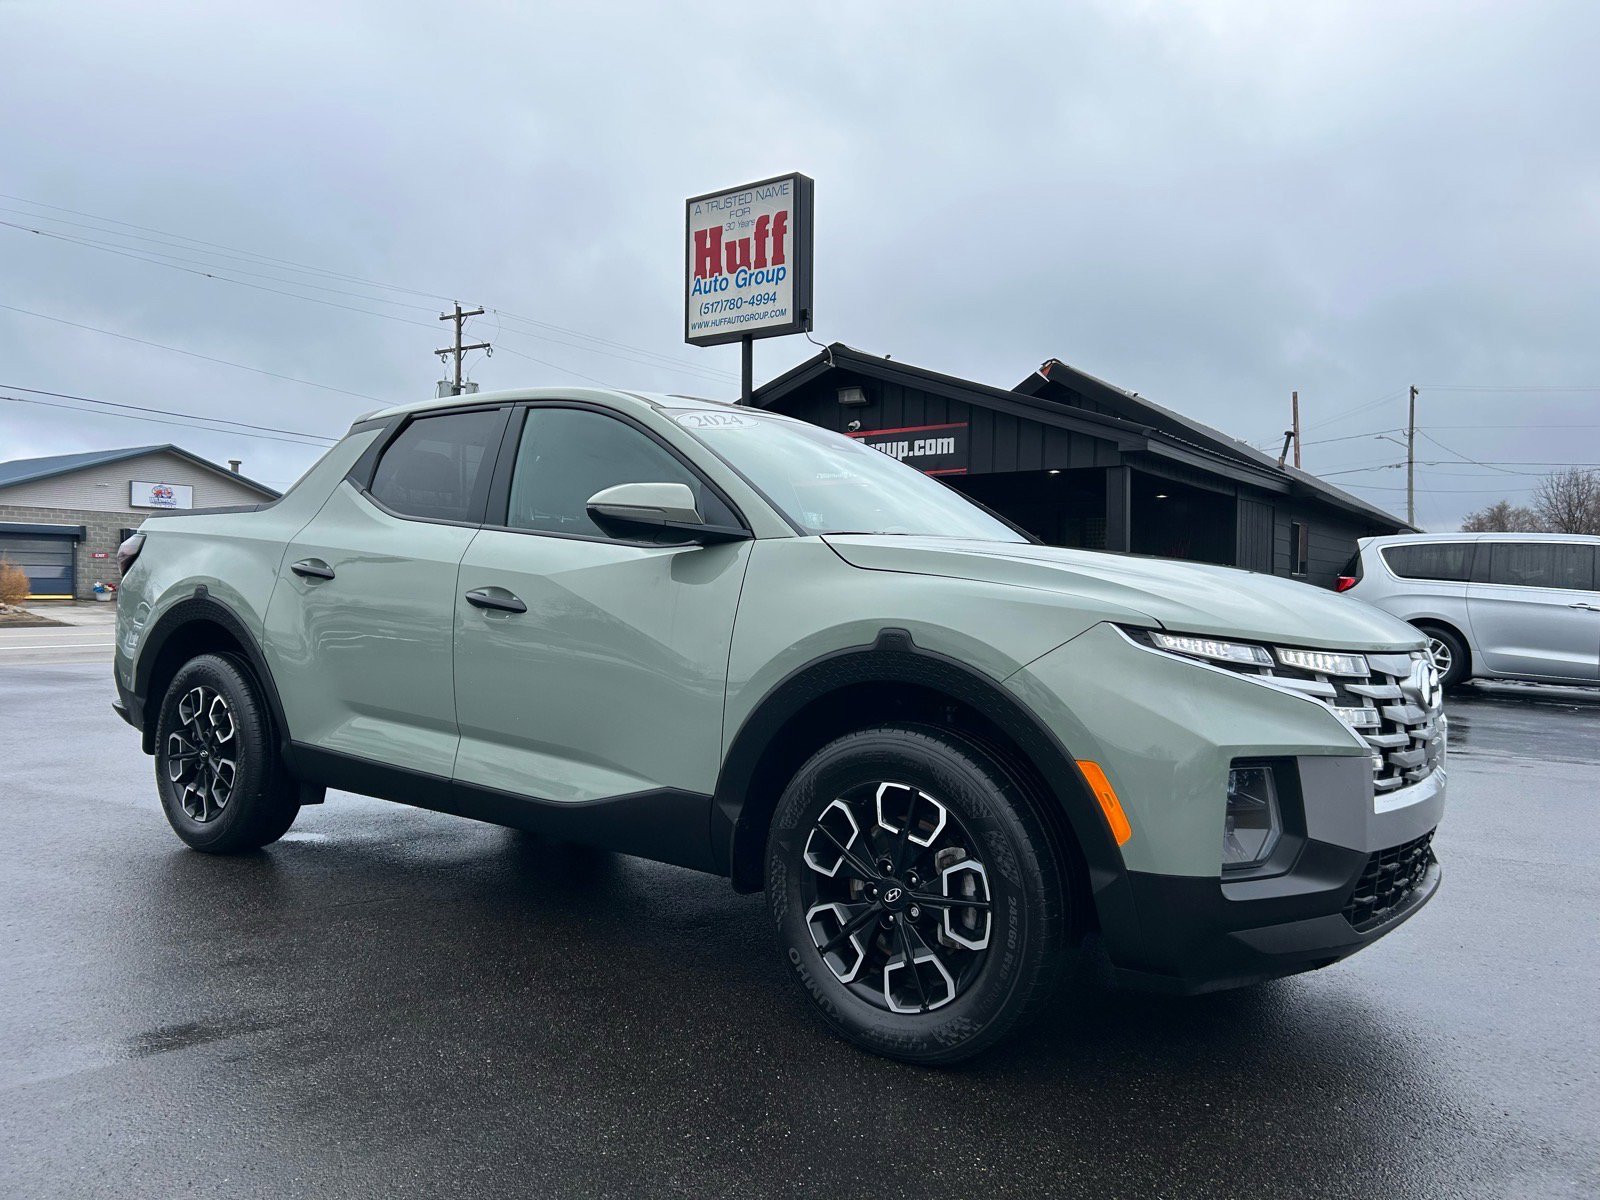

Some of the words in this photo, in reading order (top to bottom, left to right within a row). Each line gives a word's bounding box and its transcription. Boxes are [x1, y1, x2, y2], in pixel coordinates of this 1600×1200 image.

[694, 205, 702, 216] A
[705, 192, 753, 213] TRUSTED
[756, 183, 790, 201] NAME
[725, 221, 736, 232] 30
[737, 218, 756, 229] Years
[729, 207, 751, 219] FOR
[694, 210, 788, 281] Huff
[692, 275, 729, 296] Auto
[735, 266, 787, 289] Group
[699, 291, 777, 316] (517)780-4994
[691, 308, 787, 331] WWW.HUFFAUTOGROUP.COM
[689, 414, 744, 427] 2024
